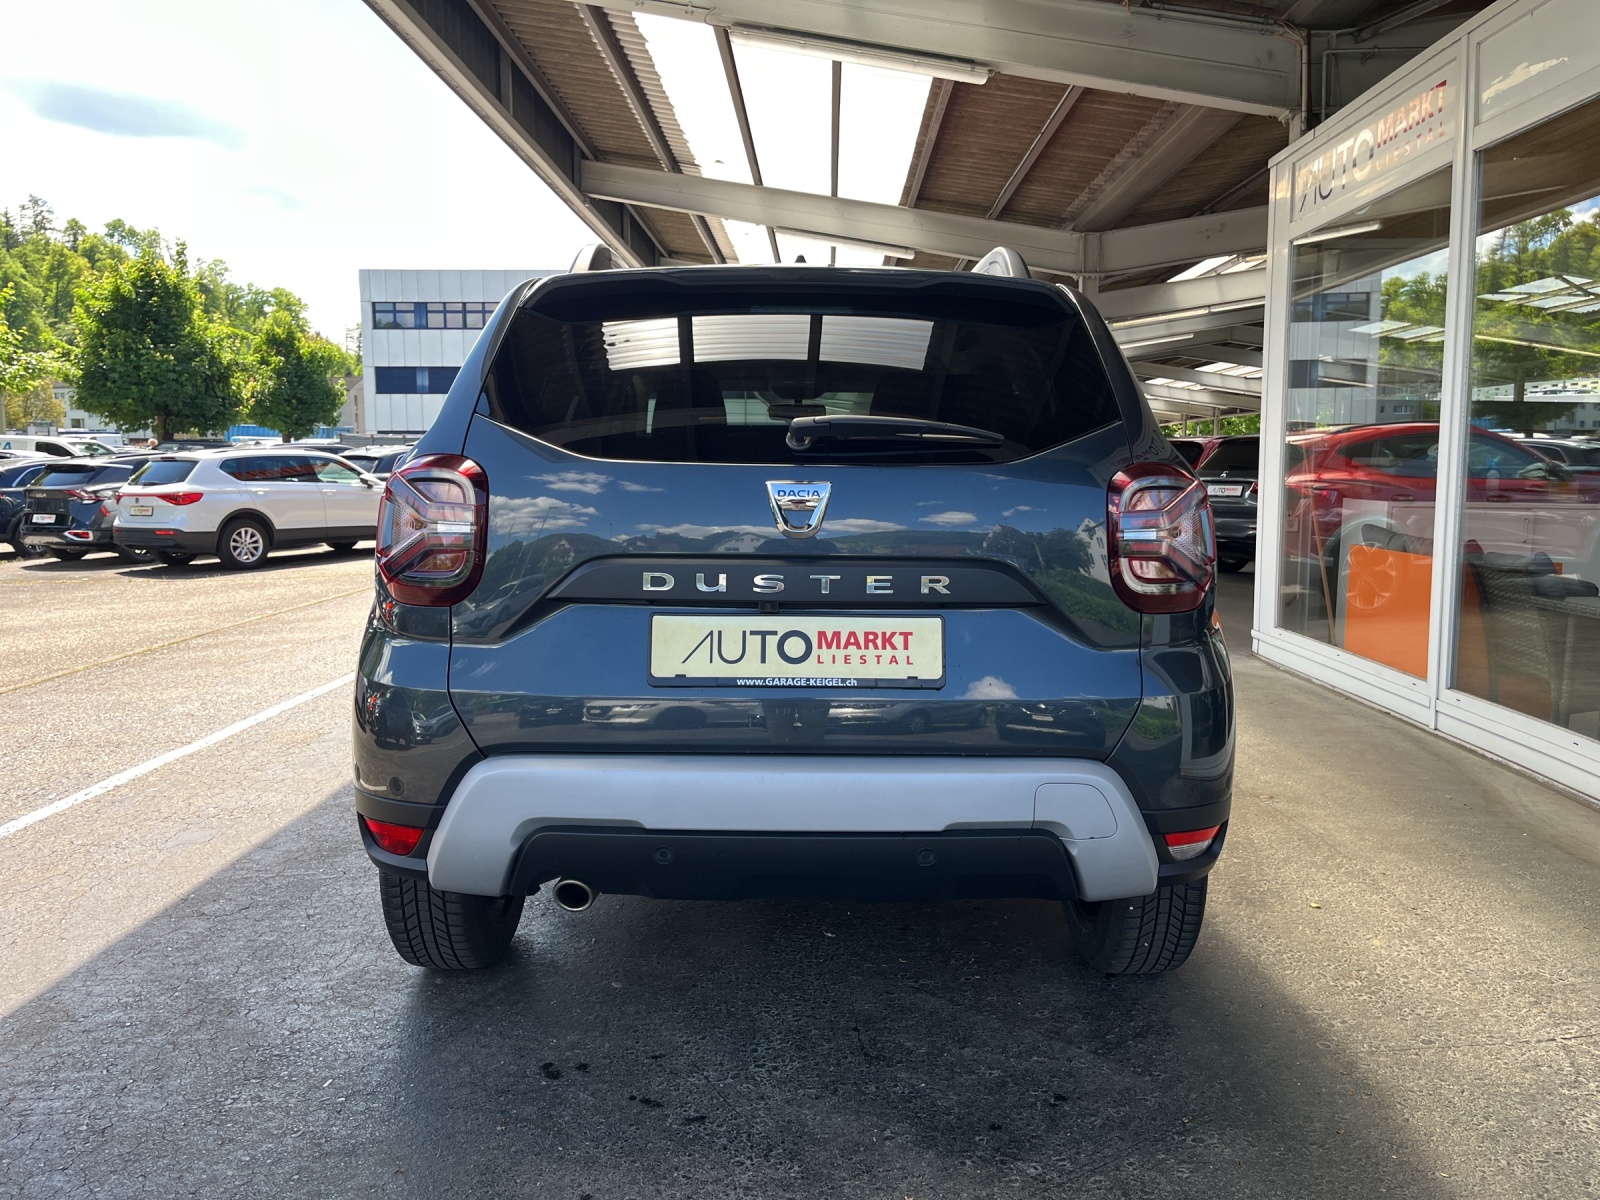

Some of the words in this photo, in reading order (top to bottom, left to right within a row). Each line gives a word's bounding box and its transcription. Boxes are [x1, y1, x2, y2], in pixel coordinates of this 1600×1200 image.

[1300, 128, 1375, 213] AUTO
[1377, 79, 1448, 149] MARKT
[1376, 121, 1446, 171] LIESTAL
[777, 489, 821, 498] DACIA
[642, 572, 951, 595] DUSTER
[681, 629, 813, 665] AUTO
[817, 630, 914, 651] MARKT
[817, 654, 914, 665] LIESTAL
[736, 677, 858, 687] www.GARAGE-KEIGEL.ch
